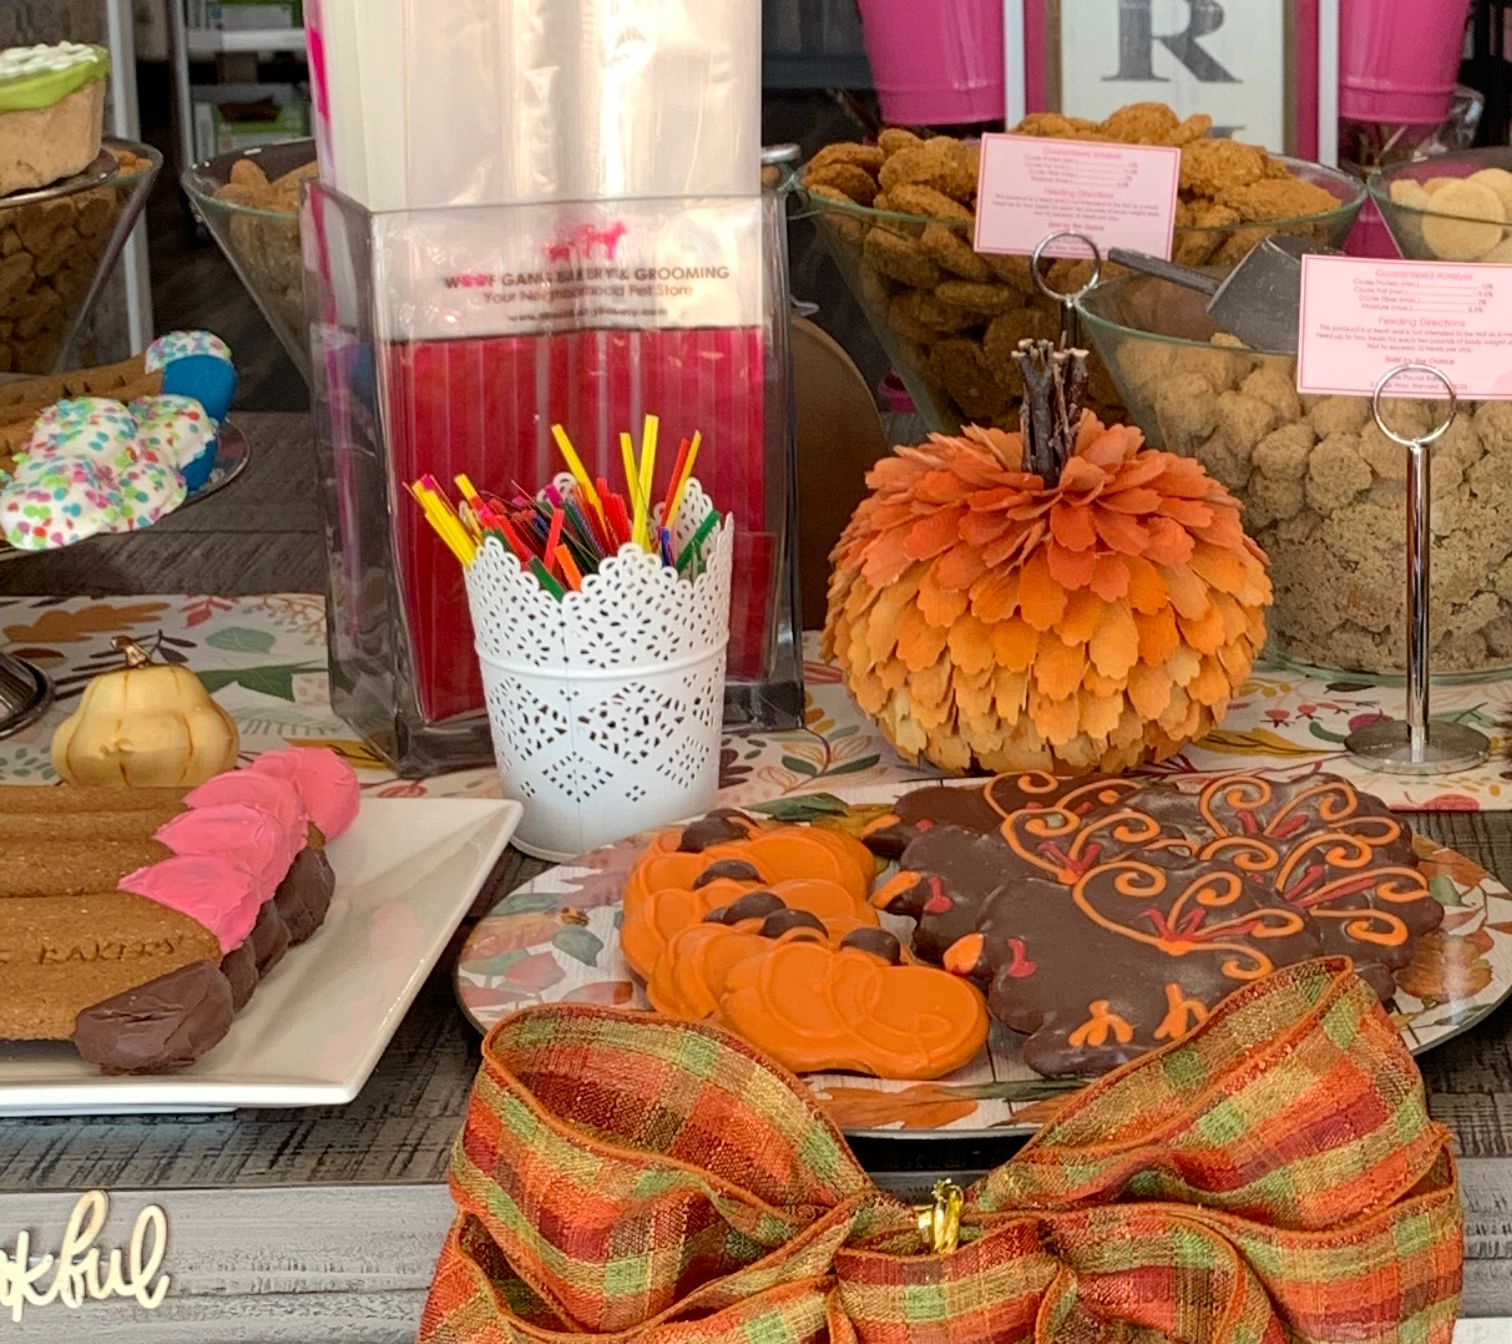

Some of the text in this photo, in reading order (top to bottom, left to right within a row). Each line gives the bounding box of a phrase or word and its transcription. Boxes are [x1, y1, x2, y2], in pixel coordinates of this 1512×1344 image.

[634, 266, 730, 283] GROOMING
[484, 289, 517, 303] Your
[629, 285, 651, 297] Pet
[656, 284, 693, 297] Store
[1378, 316, 1466, 327] Feeding Directions
[0, 1189, 171, 1323] kful
